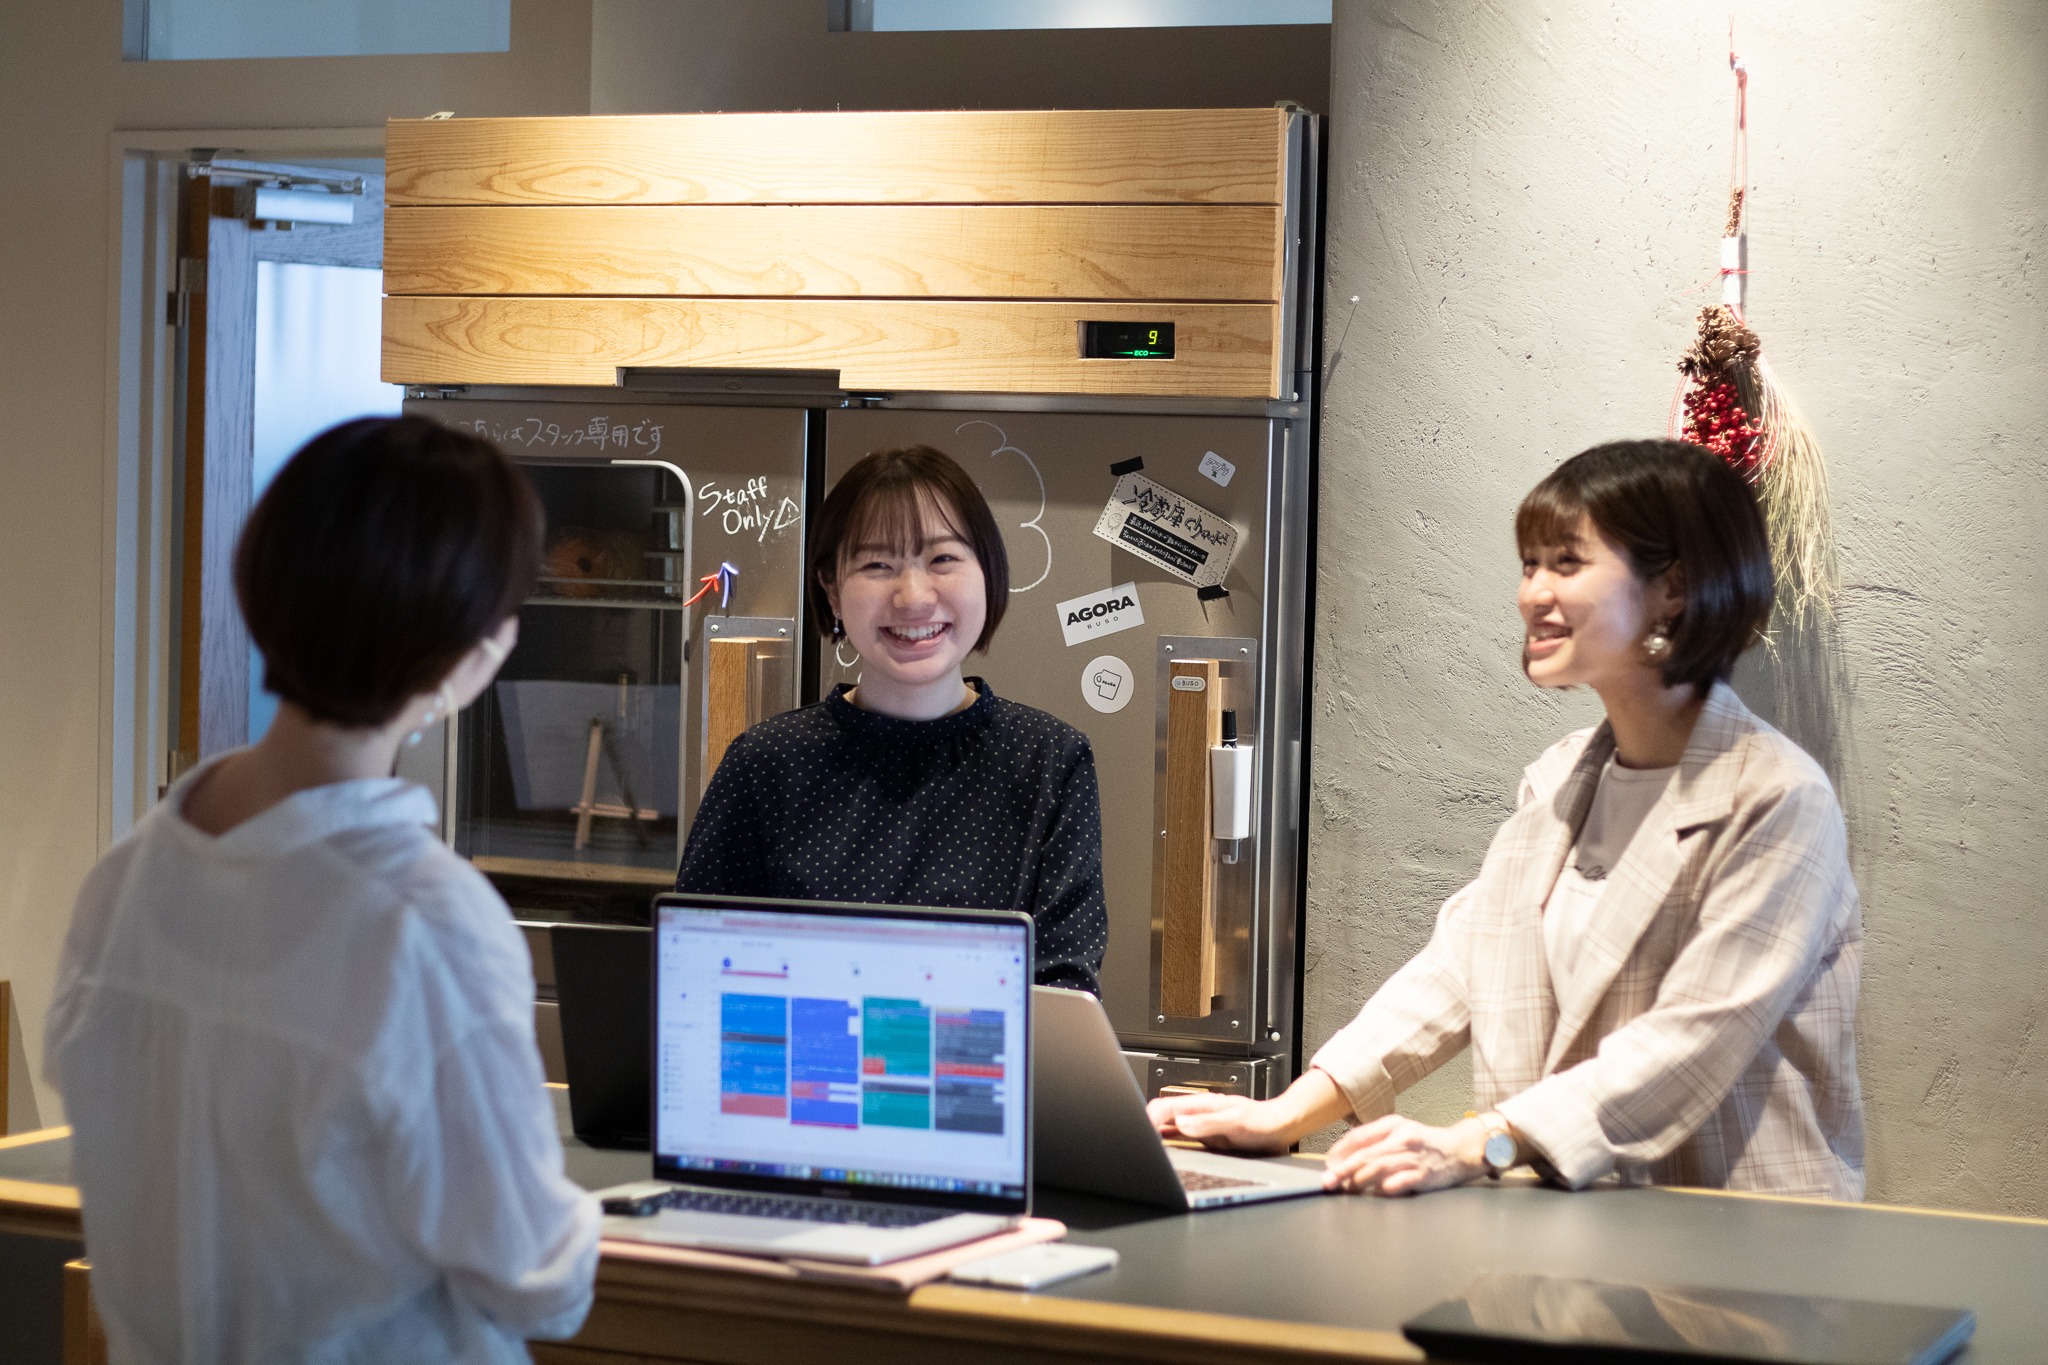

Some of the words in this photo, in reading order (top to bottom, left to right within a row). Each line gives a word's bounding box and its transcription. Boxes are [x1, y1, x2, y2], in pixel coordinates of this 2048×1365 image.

[1148, 330, 1158, 345] 9
[1133, 349, 1149, 357] ECO
[698, 476, 767, 516] Staff
[722, 504, 775, 542] Only
[1066, 595, 1135, 626] AGORA
[1087, 616, 1119, 630] BUSO
